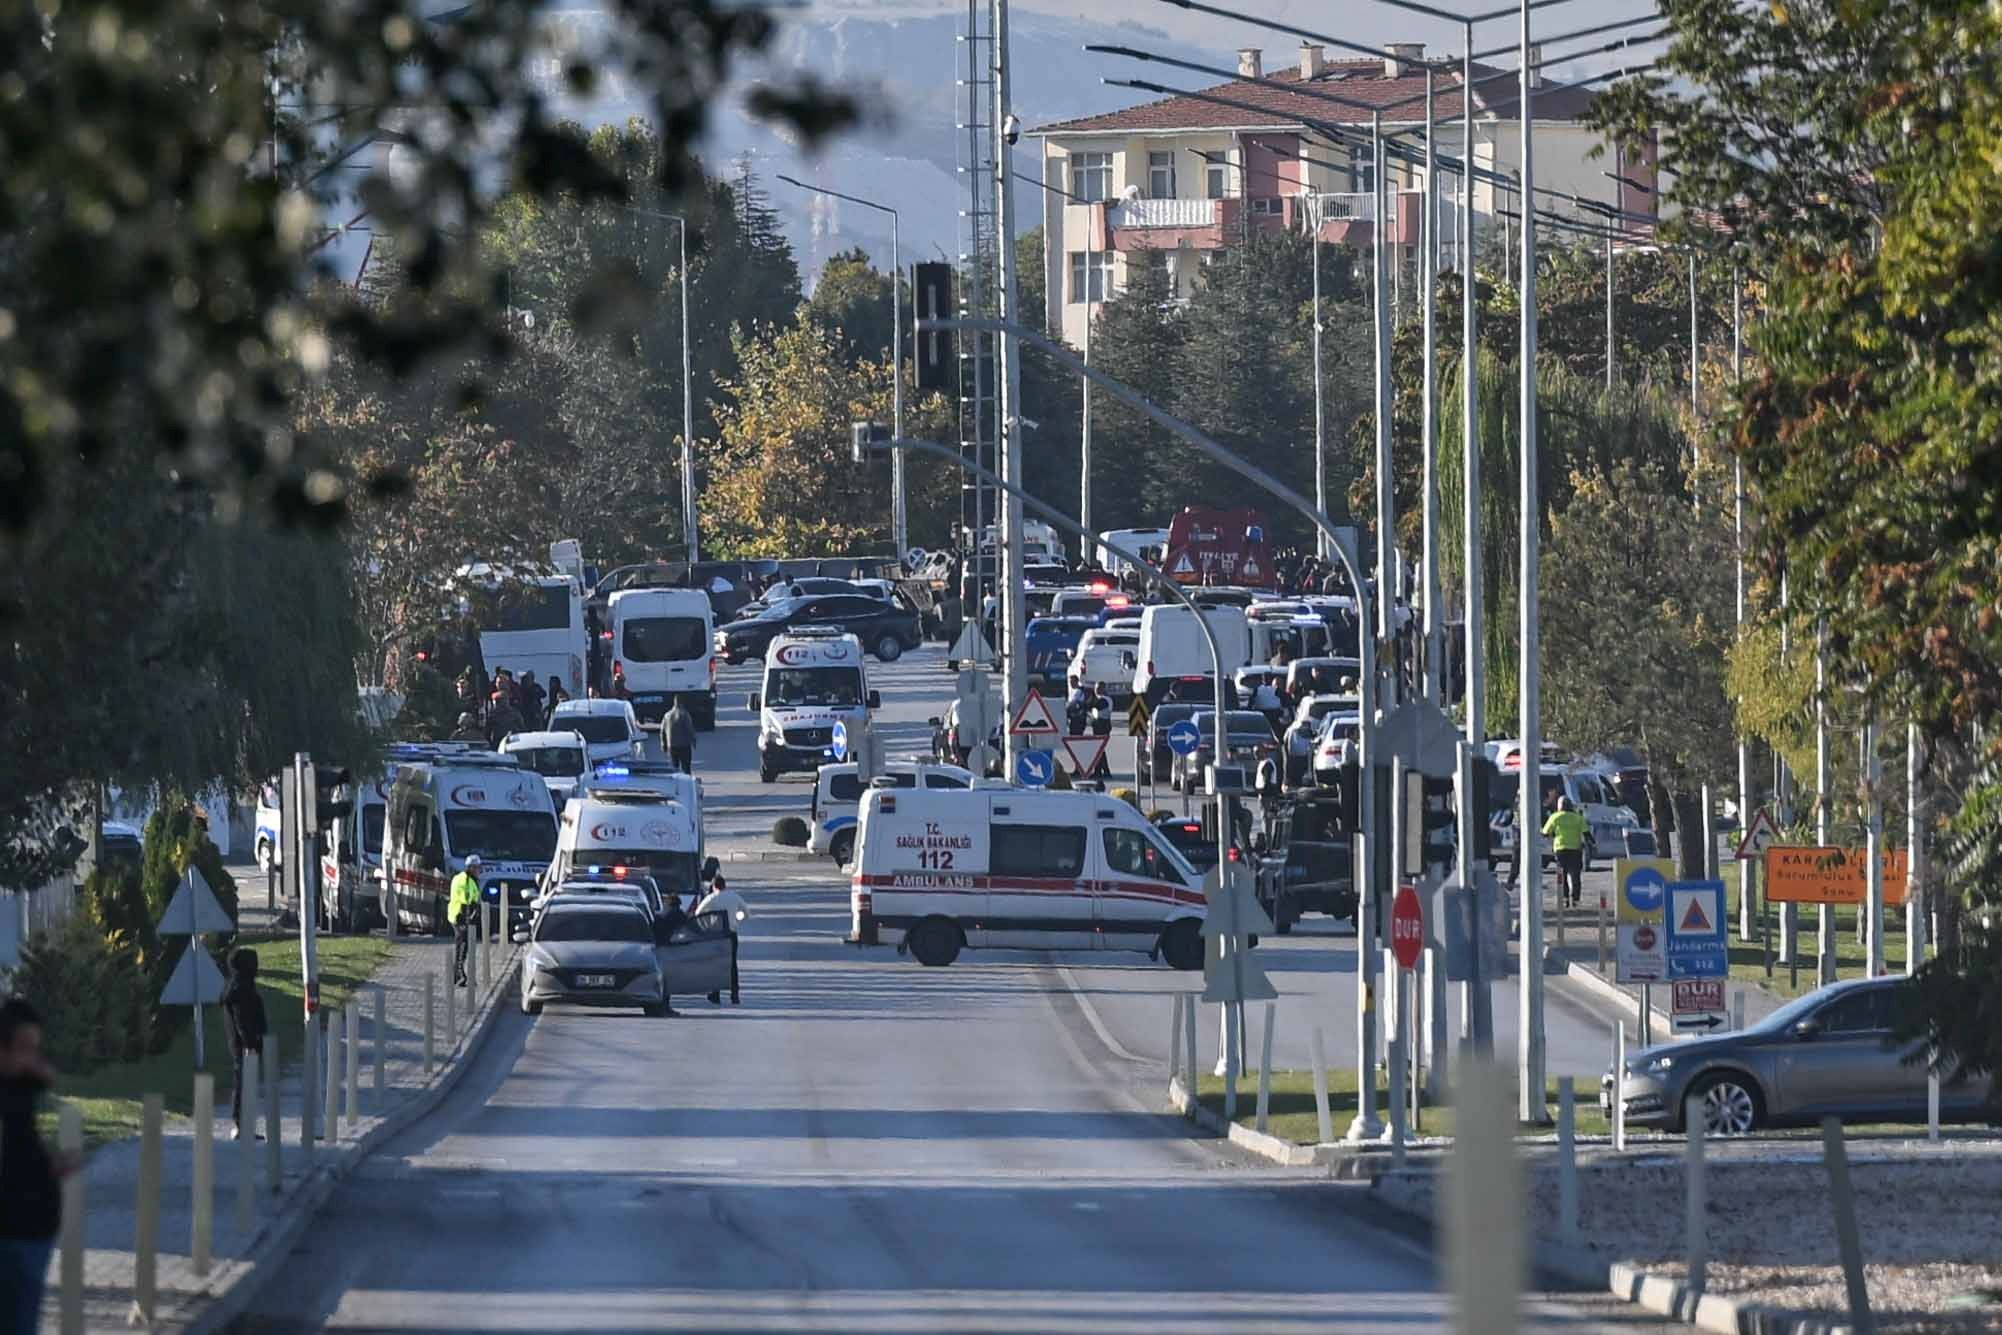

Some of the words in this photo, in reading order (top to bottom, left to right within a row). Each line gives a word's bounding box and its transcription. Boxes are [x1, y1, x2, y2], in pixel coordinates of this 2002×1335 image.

[786, 649, 809, 660] 112
[896, 835, 924, 849] SAĞLIK
[917, 850, 954, 869] 112
[893, 873, 975, 888] AMBULANS
[1395, 918, 1421, 939] DUR
[1679, 982, 1720, 995] DUR
